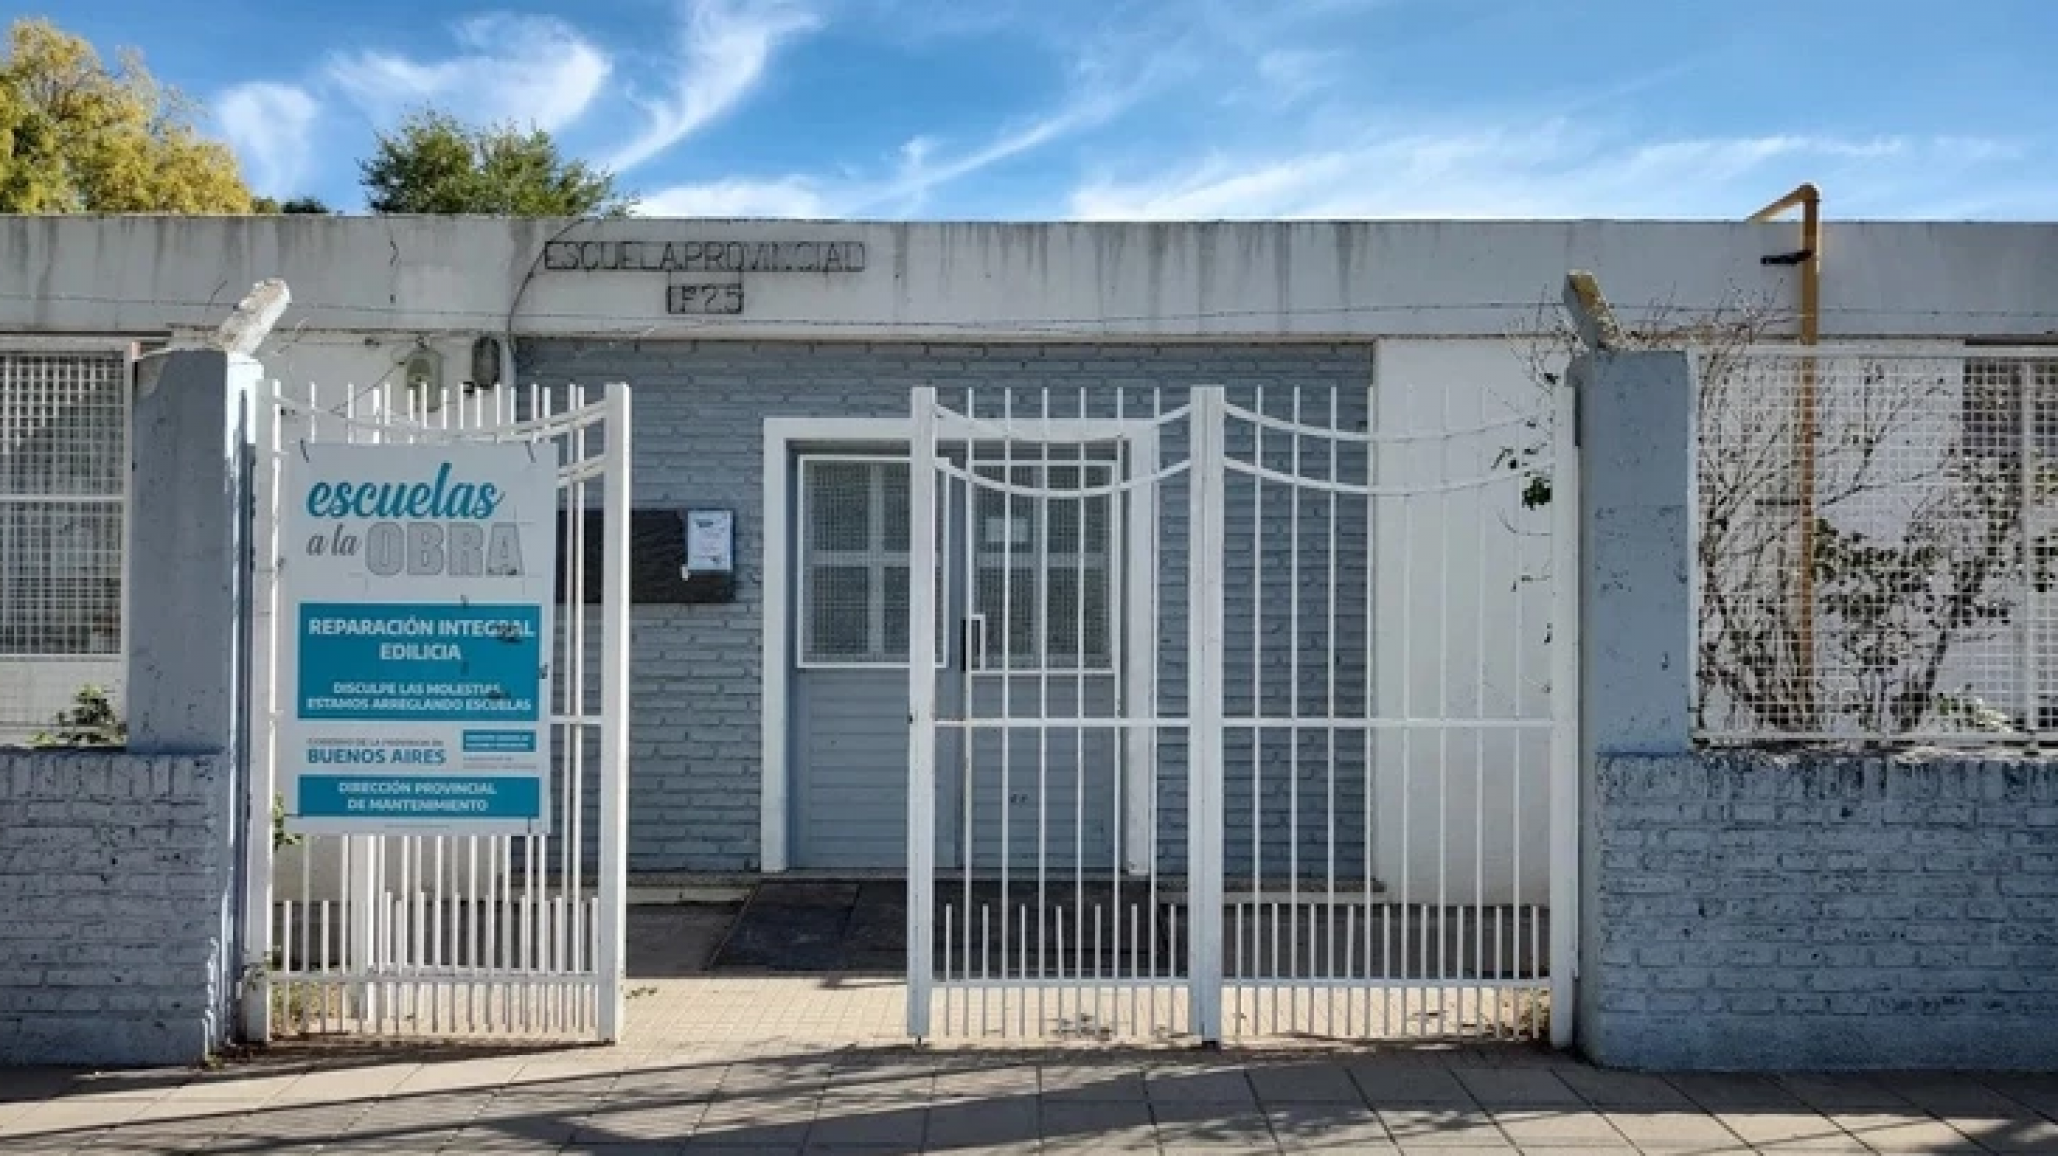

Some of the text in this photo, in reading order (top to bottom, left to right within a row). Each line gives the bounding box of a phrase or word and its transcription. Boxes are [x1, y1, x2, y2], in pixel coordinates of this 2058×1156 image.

[544, 241, 683, 271] ESCUELA
[306, 460, 505, 519] escuelas
[305, 521, 525, 576] a la OBRA
[308, 615, 536, 637] REPARACIÓN INTEGRAL
[379, 643, 461, 660] EDILICIA
[333, 683, 396, 694] DISCULPE
[399, 683, 424, 694] LAS
[306, 698, 531, 711] ESTAMOS ARREGLANDO ESCUELAS
[307, 748, 385, 764] BUENOS
[390, 748, 447, 765] AIRES
[337, 780, 498, 795] DIRECCIÓN PROVINCIAL
[347, 799, 489, 812] DE MANTENIMIENTO
